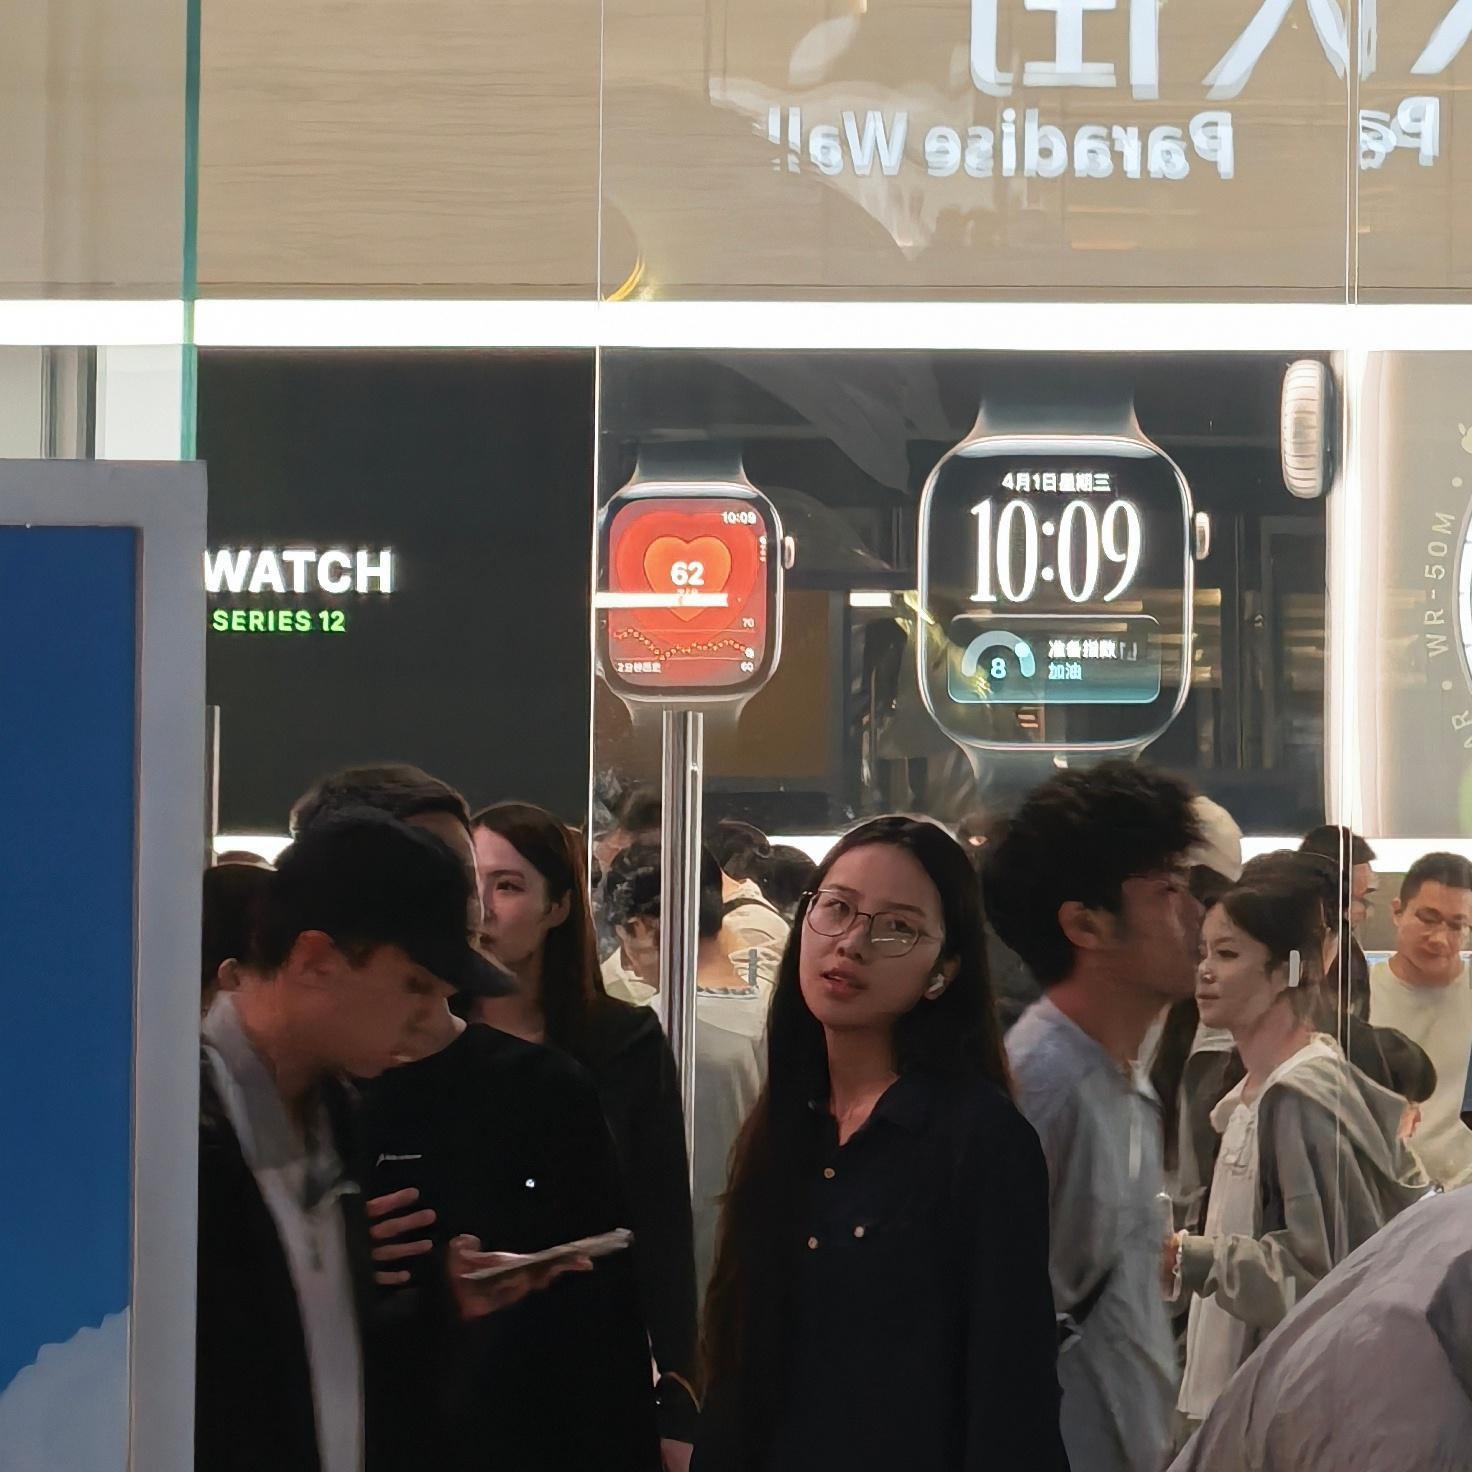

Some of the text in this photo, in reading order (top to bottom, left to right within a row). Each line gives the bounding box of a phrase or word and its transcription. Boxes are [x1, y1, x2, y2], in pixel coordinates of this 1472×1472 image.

[968, 497, 1141, 604] 10:09
[204, 548, 392, 594] WATCH
[670, 560, 705, 587] 62
[1423, 512, 1456, 658] WR-50M
[213, 609, 346, 632] SERIES 12
[989, 658, 1008, 679] 8
[1048, 661, 1083, 681] 加油
